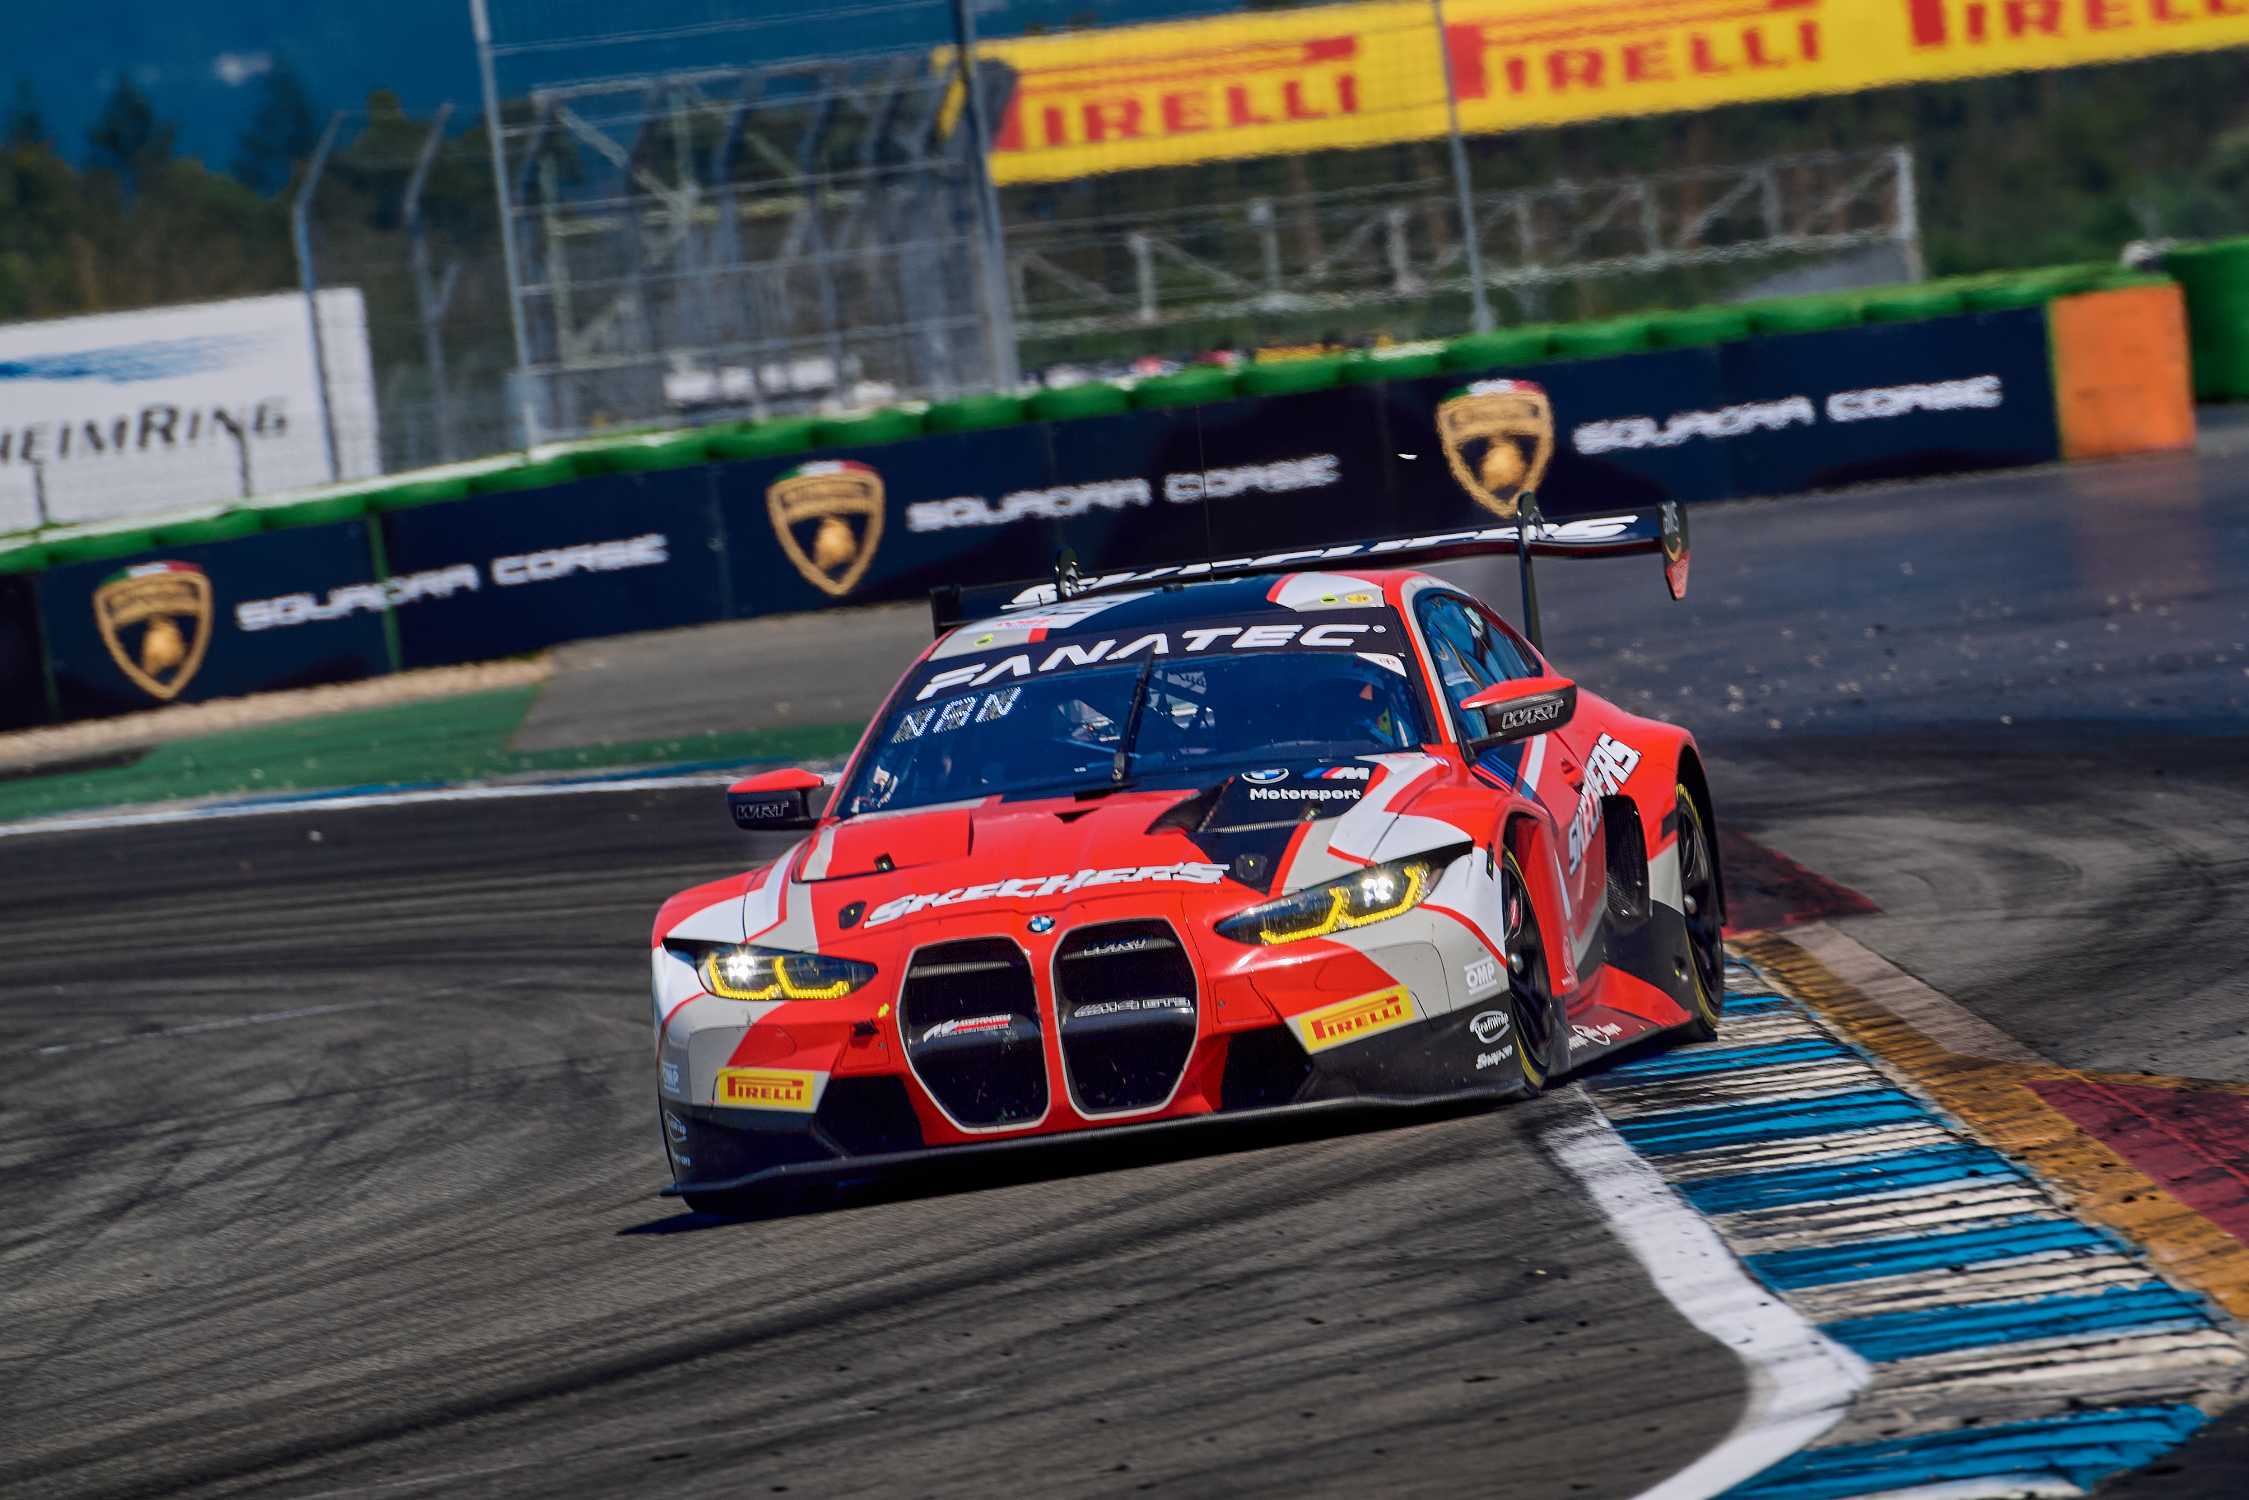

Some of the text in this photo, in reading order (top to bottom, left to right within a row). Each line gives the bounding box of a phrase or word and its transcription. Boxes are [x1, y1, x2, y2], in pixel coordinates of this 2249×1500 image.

[1502, 699, 1565, 730] WRT
[1249, 787, 1362, 802] Motorsport
[863, 861, 1231, 929] SKECHERS
[1465, 960, 1497, 989] OMP
[1310, 995, 1403, 1041] PIRELLI
[726, 1076, 805, 1101] PIRELLI
